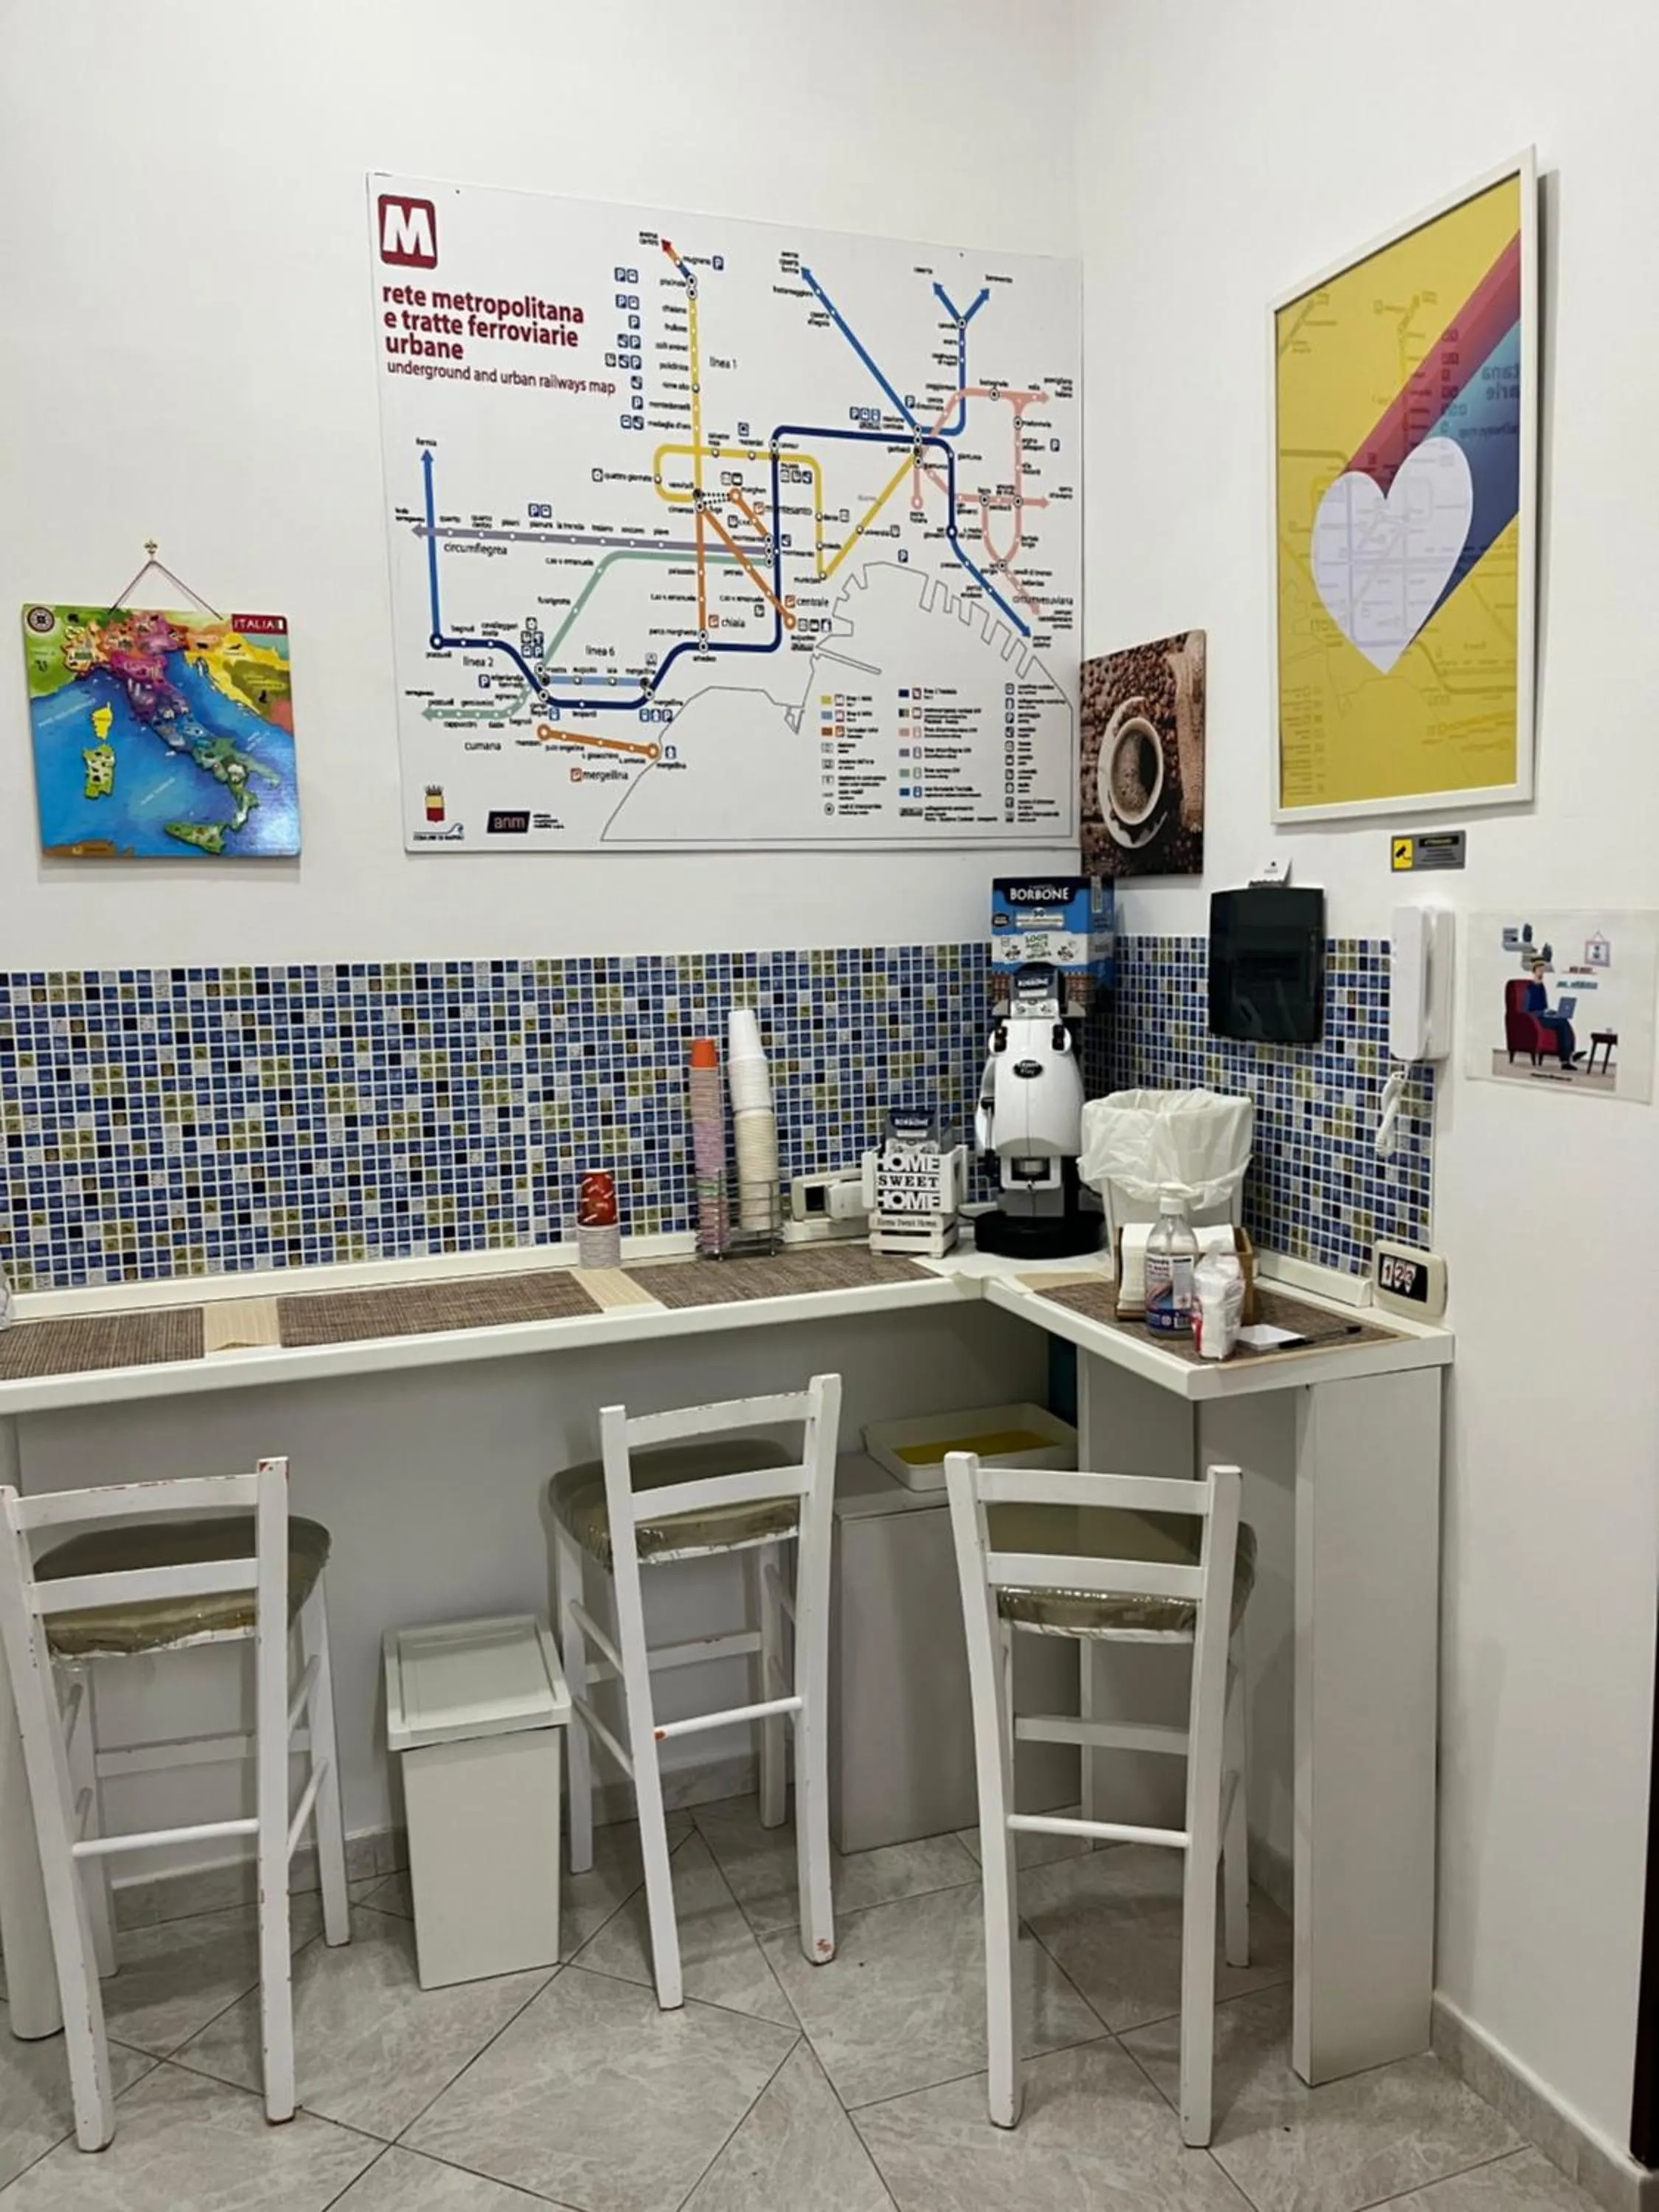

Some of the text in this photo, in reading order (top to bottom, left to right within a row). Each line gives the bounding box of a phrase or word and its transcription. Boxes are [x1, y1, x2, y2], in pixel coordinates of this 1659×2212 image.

[383, 204, 436, 256] M
[383, 285, 584, 323] rete metropolitana
[384, 310, 579, 347] e tratte ferroviarie
[386, 333, 464, 359] urbane
[387, 361, 616, 396] underground and urban railways map
[234, 619, 274, 630] ITALIA
[585, 645, 607, 656] linea
[462, 656, 486, 667] linea
[464, 742, 501, 751] cumana
[584, 770, 628, 782] mergellina
[493, 815, 525, 829] anm
[1009, 887, 1069, 900] BORBONE
[877, 1153, 941, 1173] HOME
[878, 1175, 939, 1188] SWEET
[877, 1190, 941, 1210] HOME
